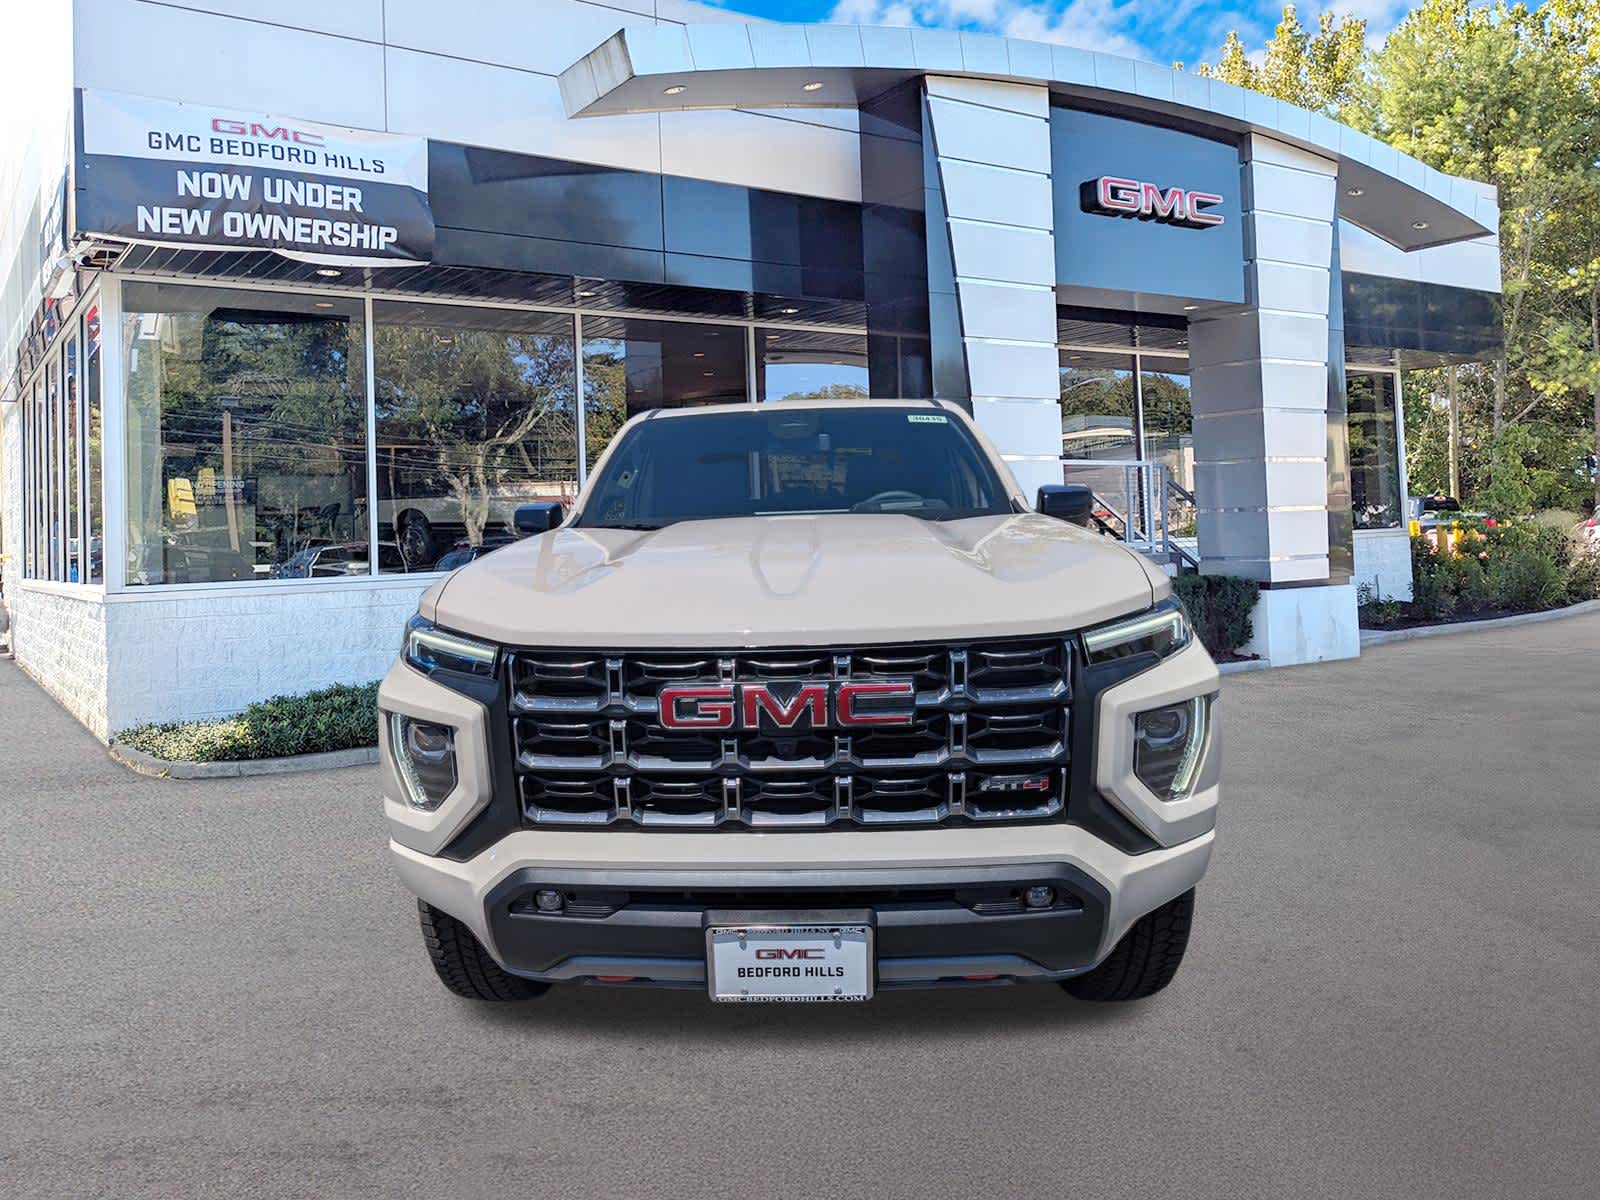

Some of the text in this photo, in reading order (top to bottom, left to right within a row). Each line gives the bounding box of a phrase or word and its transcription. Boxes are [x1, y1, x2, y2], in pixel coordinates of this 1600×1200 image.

[148, 131, 385, 174] GMC BEDFORD HILLS
[211, 117, 326, 148] GMC
[177, 170, 362, 213] NOW UNDER
[1095, 175, 1225, 225] GMC
[137, 205, 398, 250] NEW OWNERSHIP
[658, 681, 916, 729] GMC
[737, 966, 844, 978] BEDFORD HILLS
[755, 948, 825, 960] GMC
